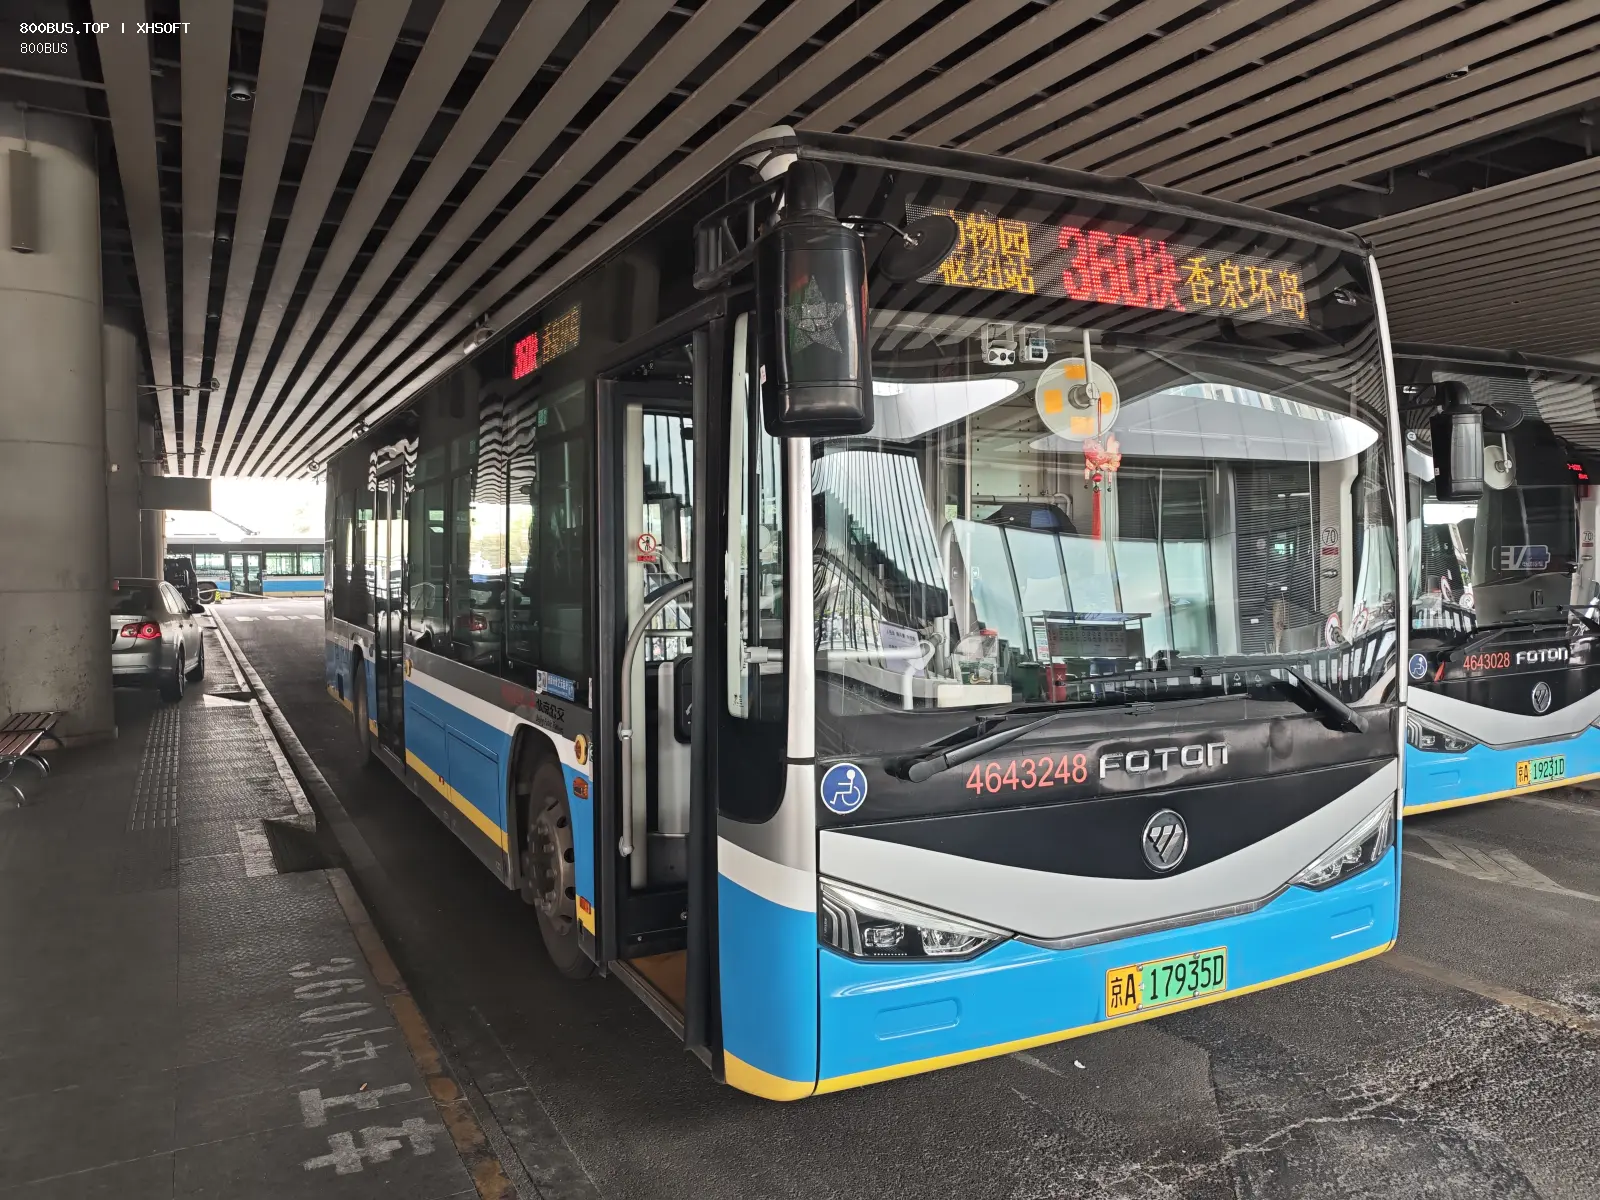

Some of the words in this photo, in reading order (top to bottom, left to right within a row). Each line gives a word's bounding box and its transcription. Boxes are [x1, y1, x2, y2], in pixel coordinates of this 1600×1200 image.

[1180, 256, 1306, 320] 香泉环岛
[1325, 529, 1336, 544] 70
[1463, 651, 1510, 671] 4643028
[1516, 647, 1568, 665] FOTON
[965, 753, 1088, 796] 4643248
[1099, 741, 1230, 780] FOTON
